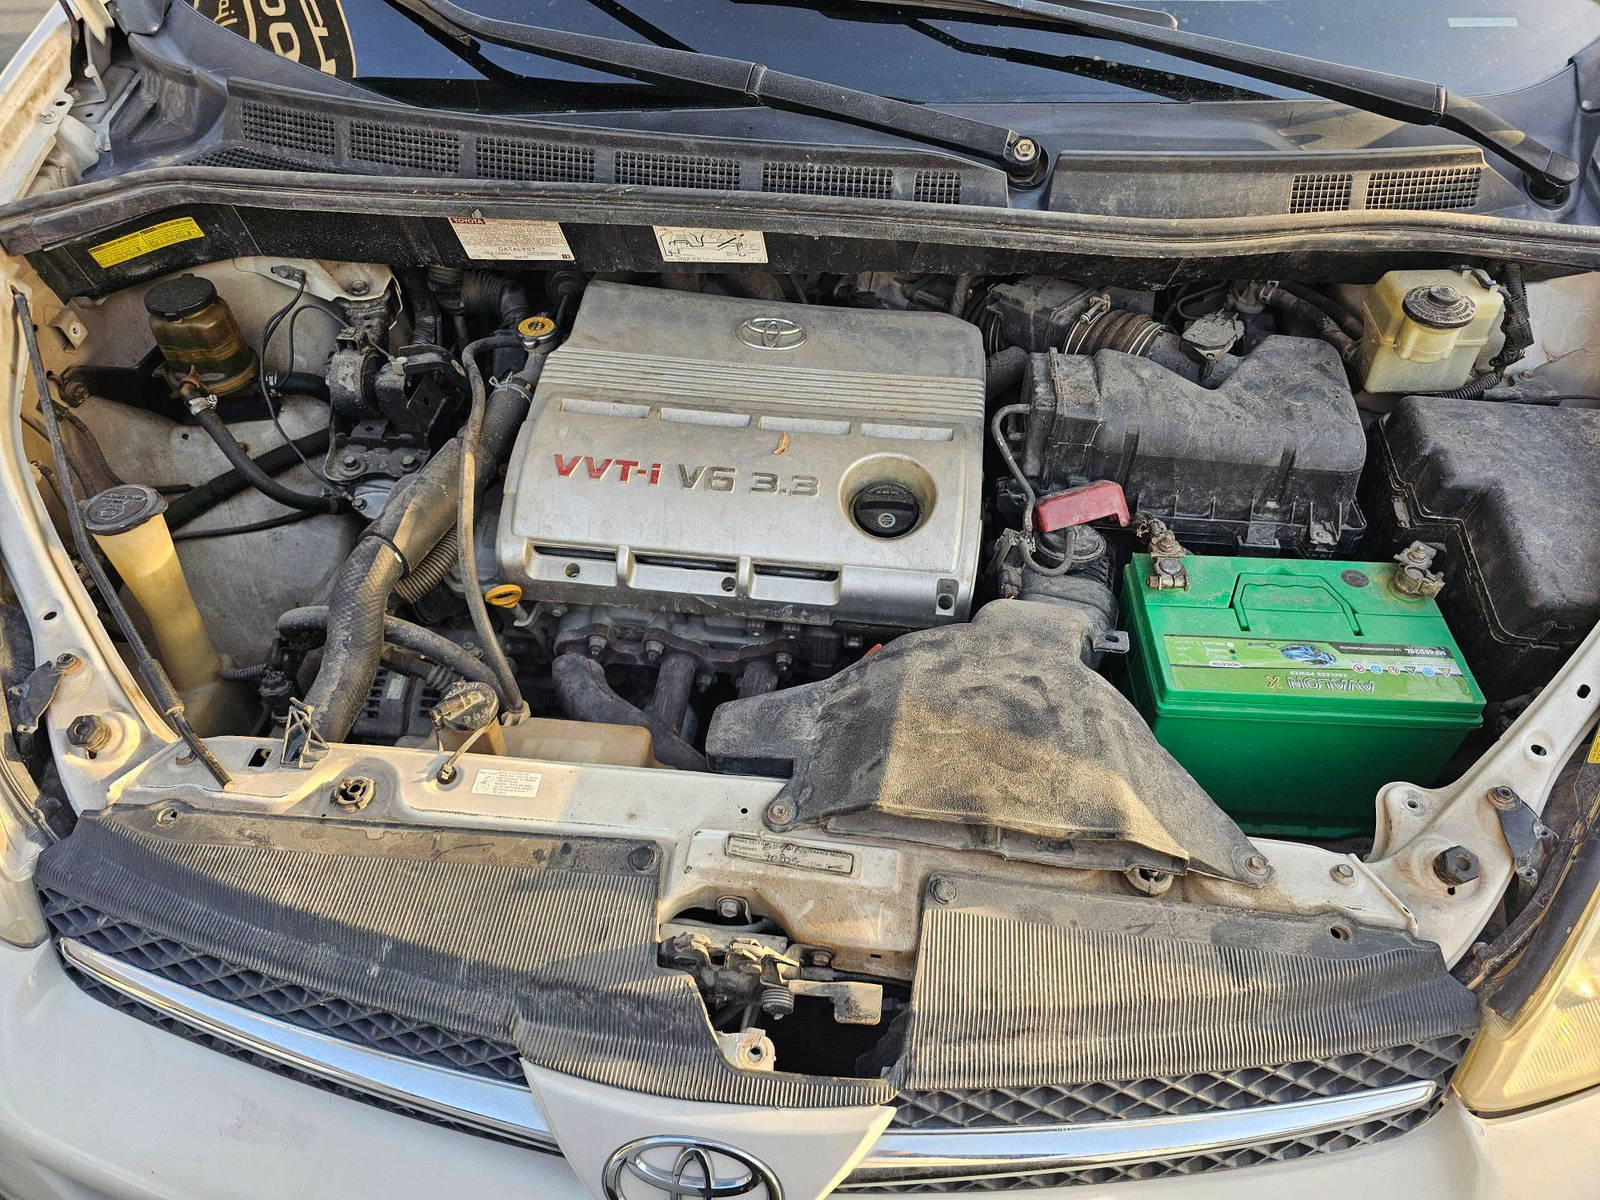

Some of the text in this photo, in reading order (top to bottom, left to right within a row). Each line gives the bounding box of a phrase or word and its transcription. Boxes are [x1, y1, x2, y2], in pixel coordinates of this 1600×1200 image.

[554, 453, 820, 498] VVT-i V6 3.3
[1265, 675, 1375, 693] AVALON X
